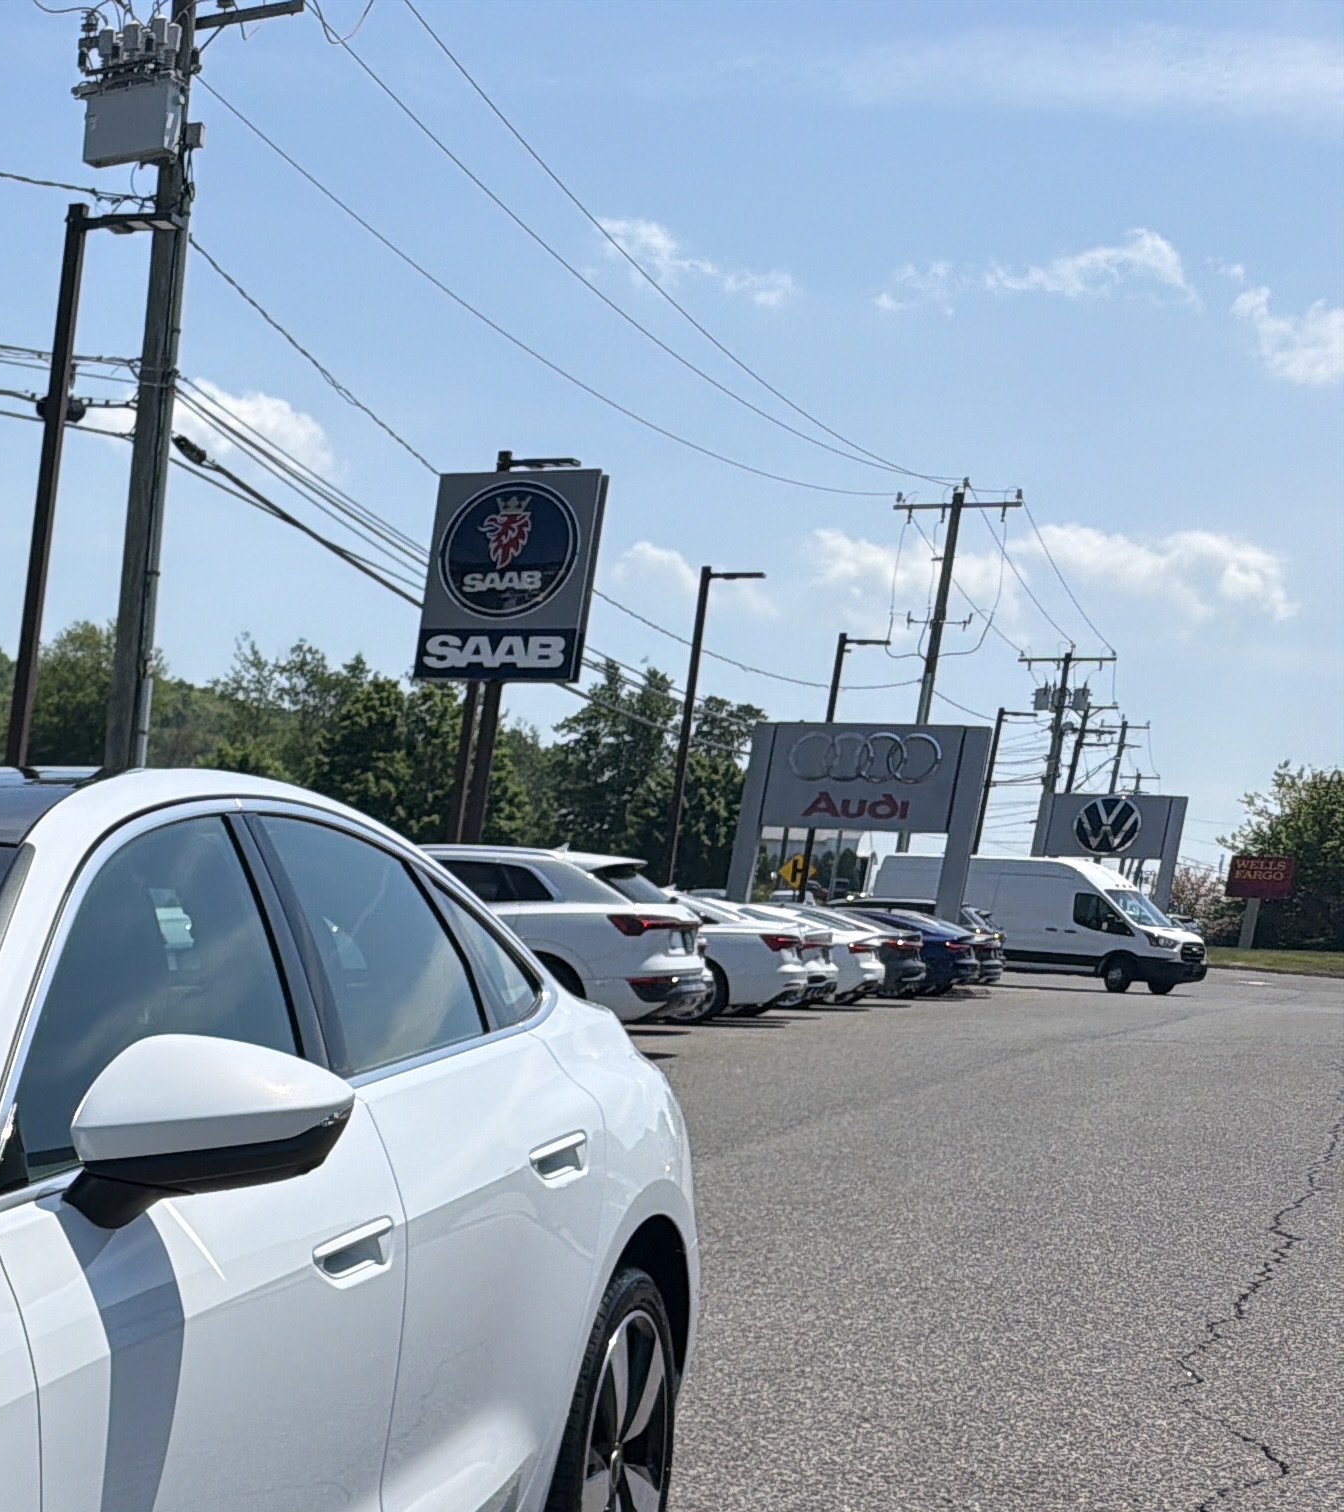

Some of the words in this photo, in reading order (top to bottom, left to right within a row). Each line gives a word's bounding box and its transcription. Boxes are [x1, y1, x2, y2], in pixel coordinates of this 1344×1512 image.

[462, 570, 542, 593] SAAB
[422, 634, 566, 669] SAAB
[800, 791, 910, 820] Audi
[1234, 869, 1284, 880] FARGO
[1235, 860, 1286, 871] WELLS
